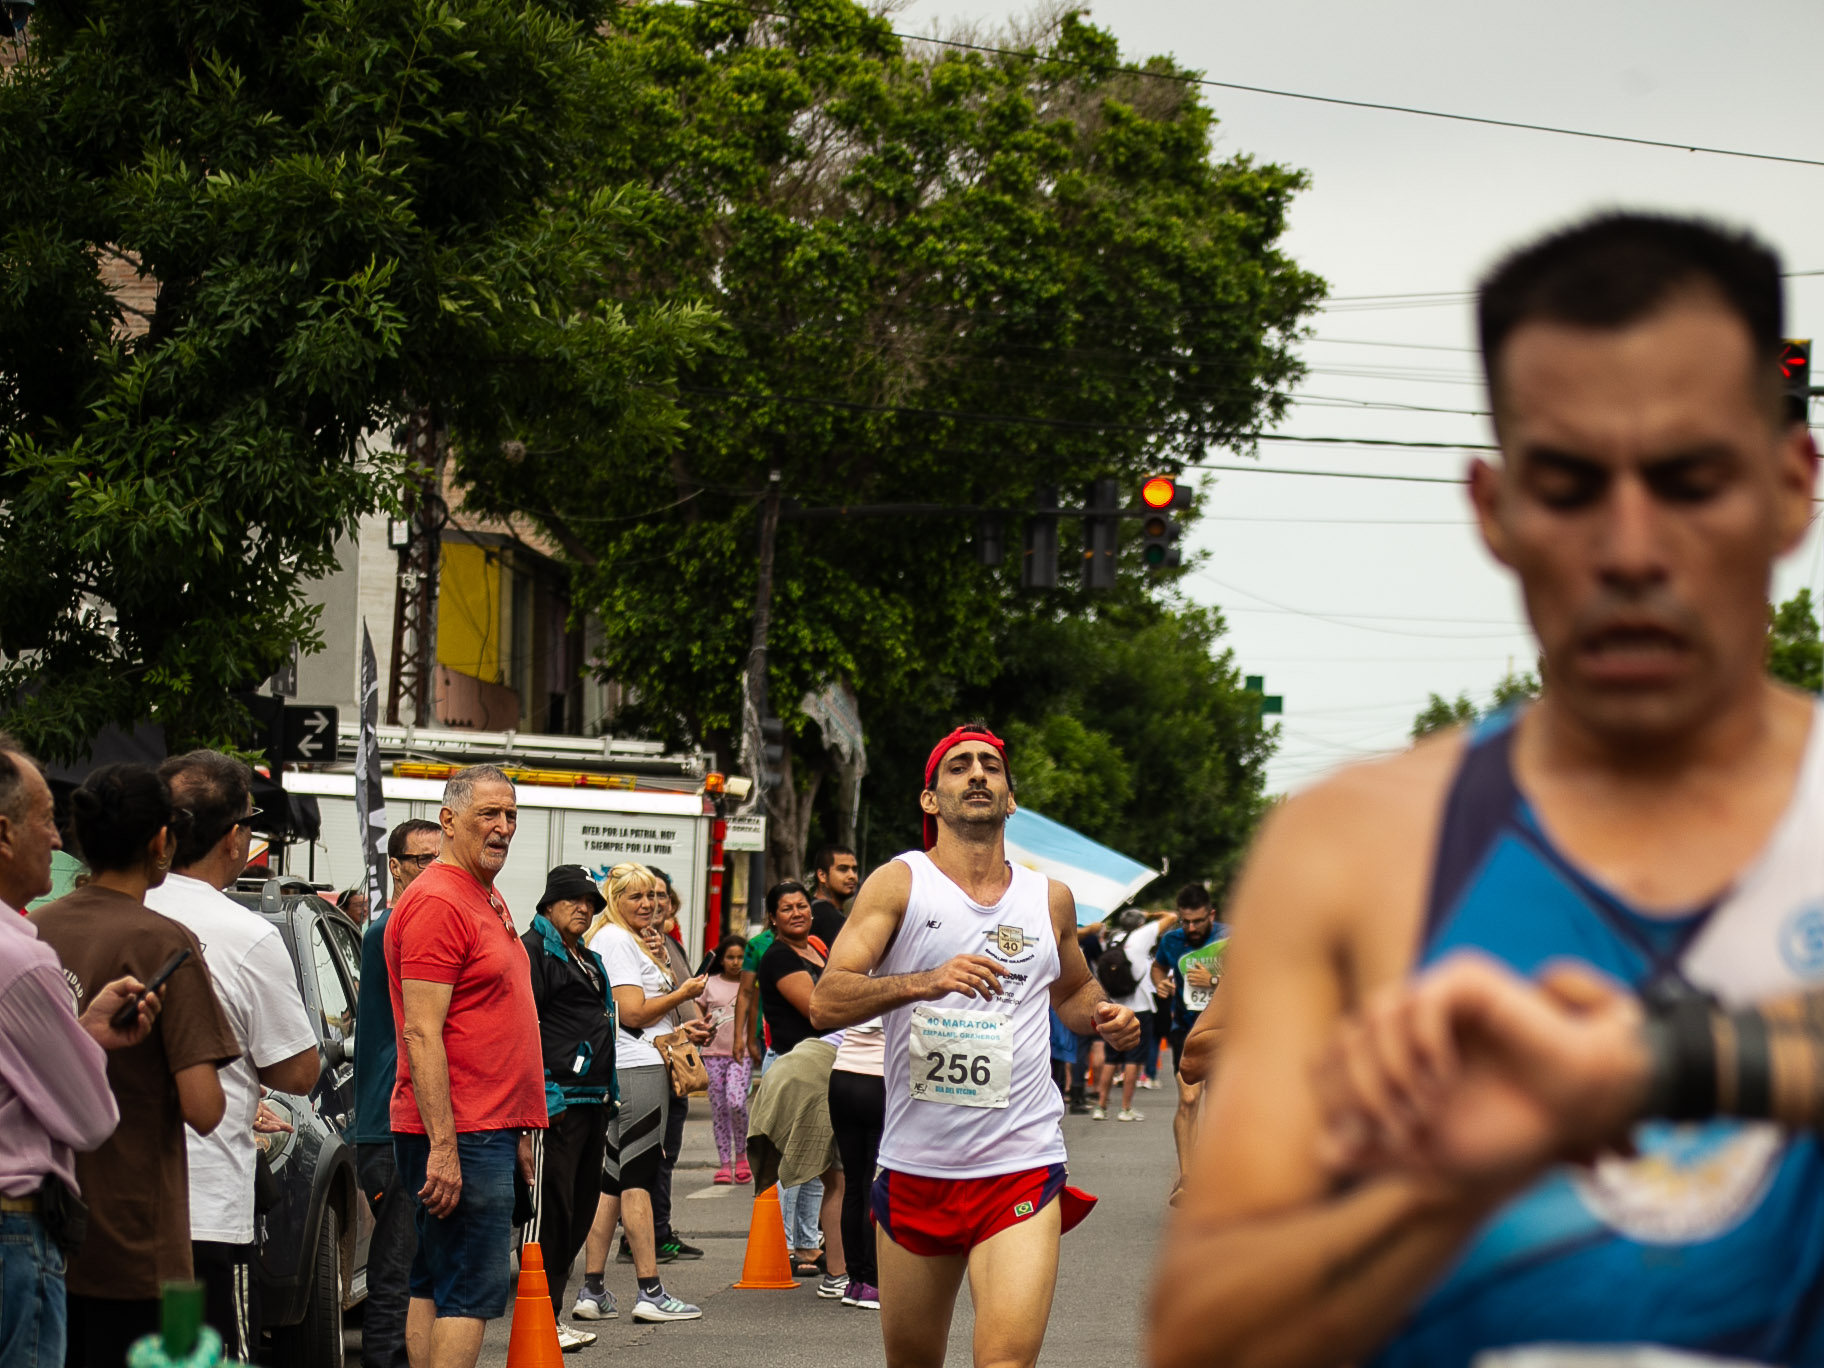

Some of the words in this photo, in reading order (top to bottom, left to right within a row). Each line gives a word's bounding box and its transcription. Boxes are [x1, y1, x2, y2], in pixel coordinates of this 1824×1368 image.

[582, 826, 600, 836] AYER
[602, 827, 617, 838] POR
[620, 828, 628, 838] LA
[660, 831, 676, 841] HOY
[584, 840, 590, 851] Y
[590, 841, 624, 853] SIEMPRE
[626, 843, 641, 853] POR
[643, 844, 652, 854] LA
[654, 844, 672, 855] VIDA
[1003, 942, 1018, 952] 40
[927, 1017, 940, 1027] 40
[942, 1018, 997, 1030] MARATON
[926, 1051, 991, 1087] 256
